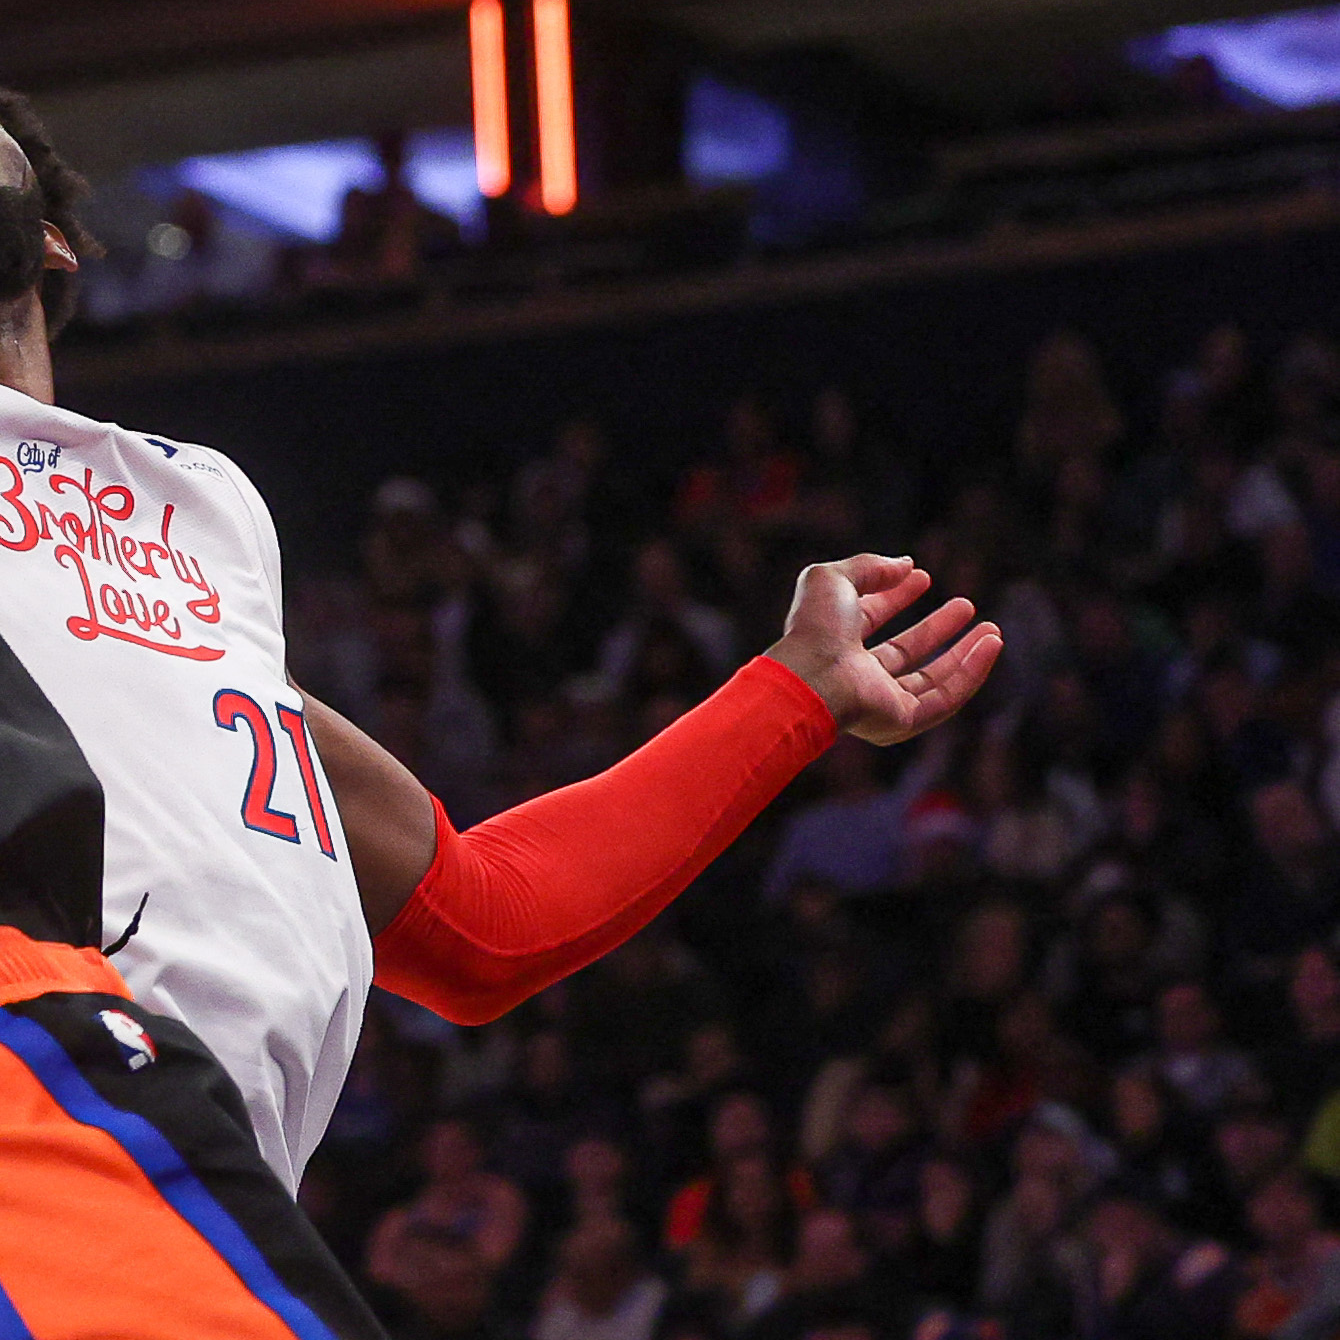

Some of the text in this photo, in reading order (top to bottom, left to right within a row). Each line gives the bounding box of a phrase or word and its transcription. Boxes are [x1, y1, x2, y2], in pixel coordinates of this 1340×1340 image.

[17, 442, 62, 475] City of
[54, 544, 226, 662] Love
[212, 688, 338, 862] 21
